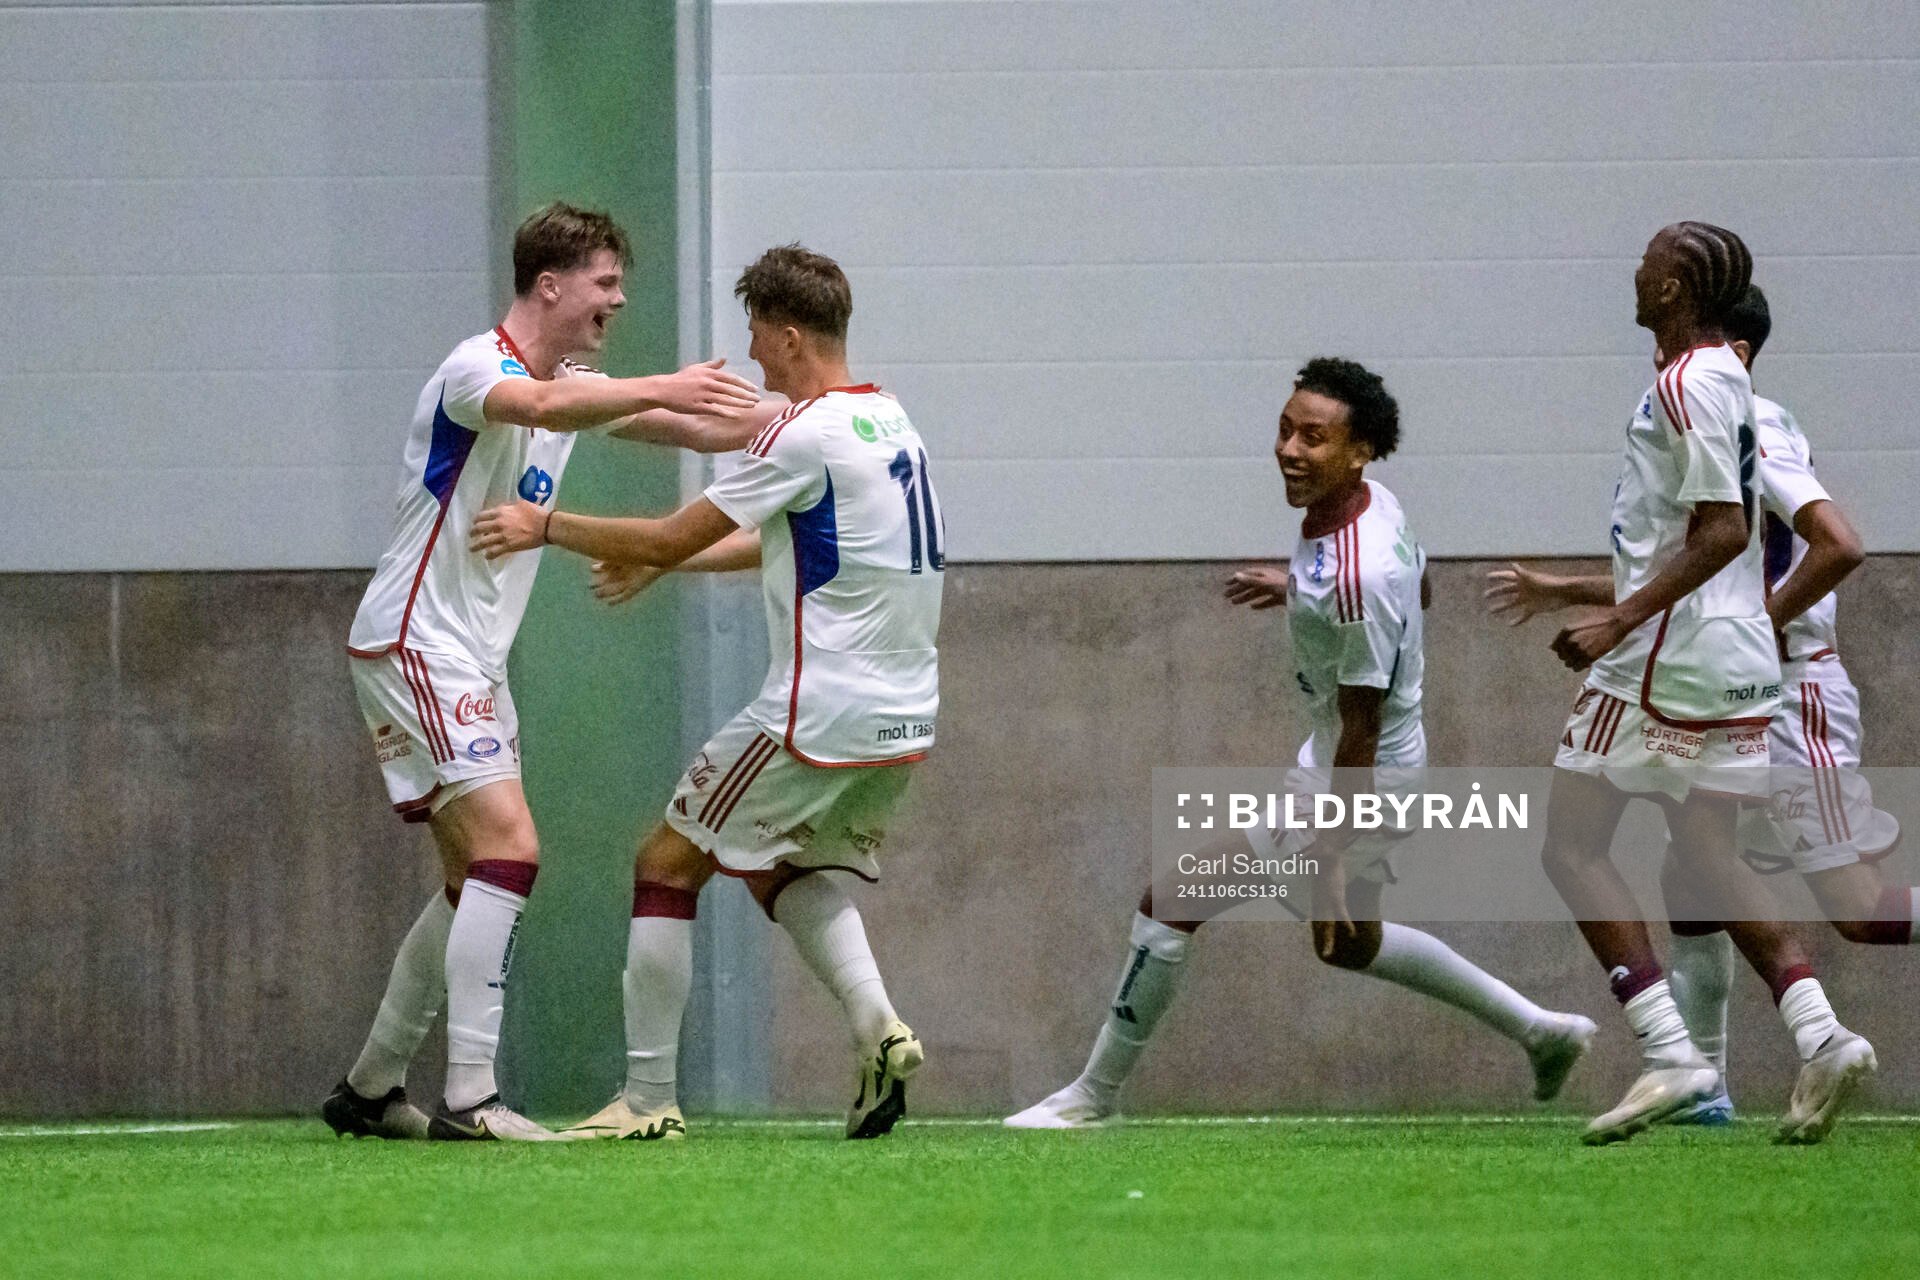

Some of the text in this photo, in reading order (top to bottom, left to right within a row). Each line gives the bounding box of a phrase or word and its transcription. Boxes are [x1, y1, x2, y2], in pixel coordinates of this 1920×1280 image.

[1723, 683, 1757, 701] mot
[455, 692, 497, 726] Coca
[877, 722, 908, 741] mot
